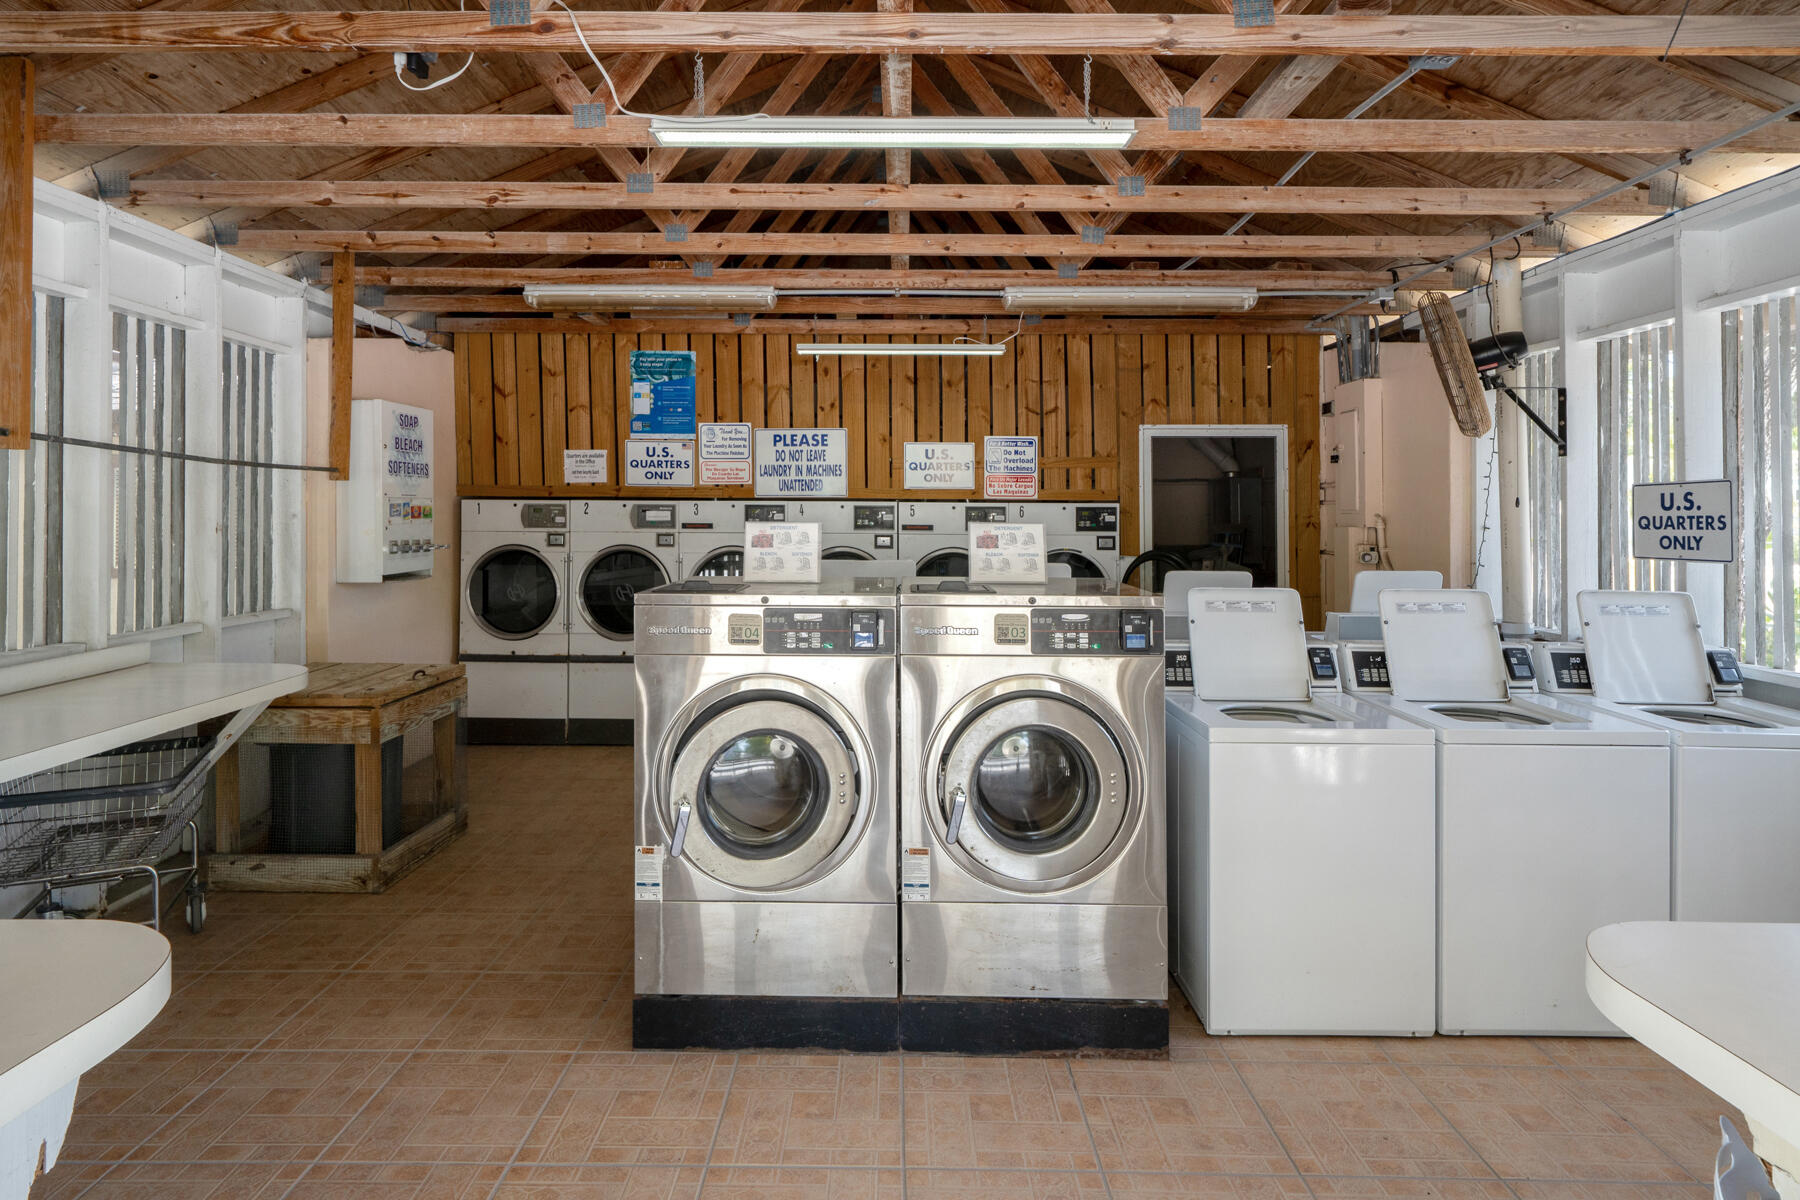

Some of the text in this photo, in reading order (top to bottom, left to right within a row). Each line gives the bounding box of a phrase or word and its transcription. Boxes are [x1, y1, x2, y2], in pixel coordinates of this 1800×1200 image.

[399, 413, 419, 428] SOAP
[394, 436, 423, 452] BLEACH
[773, 433, 829, 447] PLEASE
[645, 446, 674, 458] U.S.
[775, 449, 826, 462] DO NOT LEAVE
[925, 448, 954, 460] U.S.
[388, 459, 429, 476] SOFTENERS
[630, 459, 690, 470] QUARTERS
[759, 464, 842, 477] LAUNDRY IN MACHINES
[909, 461, 970, 471] QUARTERS
[644, 471, 674, 480] ONLY
[923, 473, 954, 483] ONLY
[779, 479, 823, 492] UNATTENDED
[1660, 491, 1702, 511] U.S.
[477, 502, 481, 515] 1
[584, 502, 589, 515] 2
[693, 503, 699, 516] 3
[799, 504, 804, 516] 4
[910, 504, 915, 517] 5
[1019, 505, 1024, 518] 6
[1638, 515, 1728, 531] QUARTERS
[1659, 535, 1704, 551] ONLY
[744, 627, 759, 639] 04
[1011, 627, 1026, 639] 03
